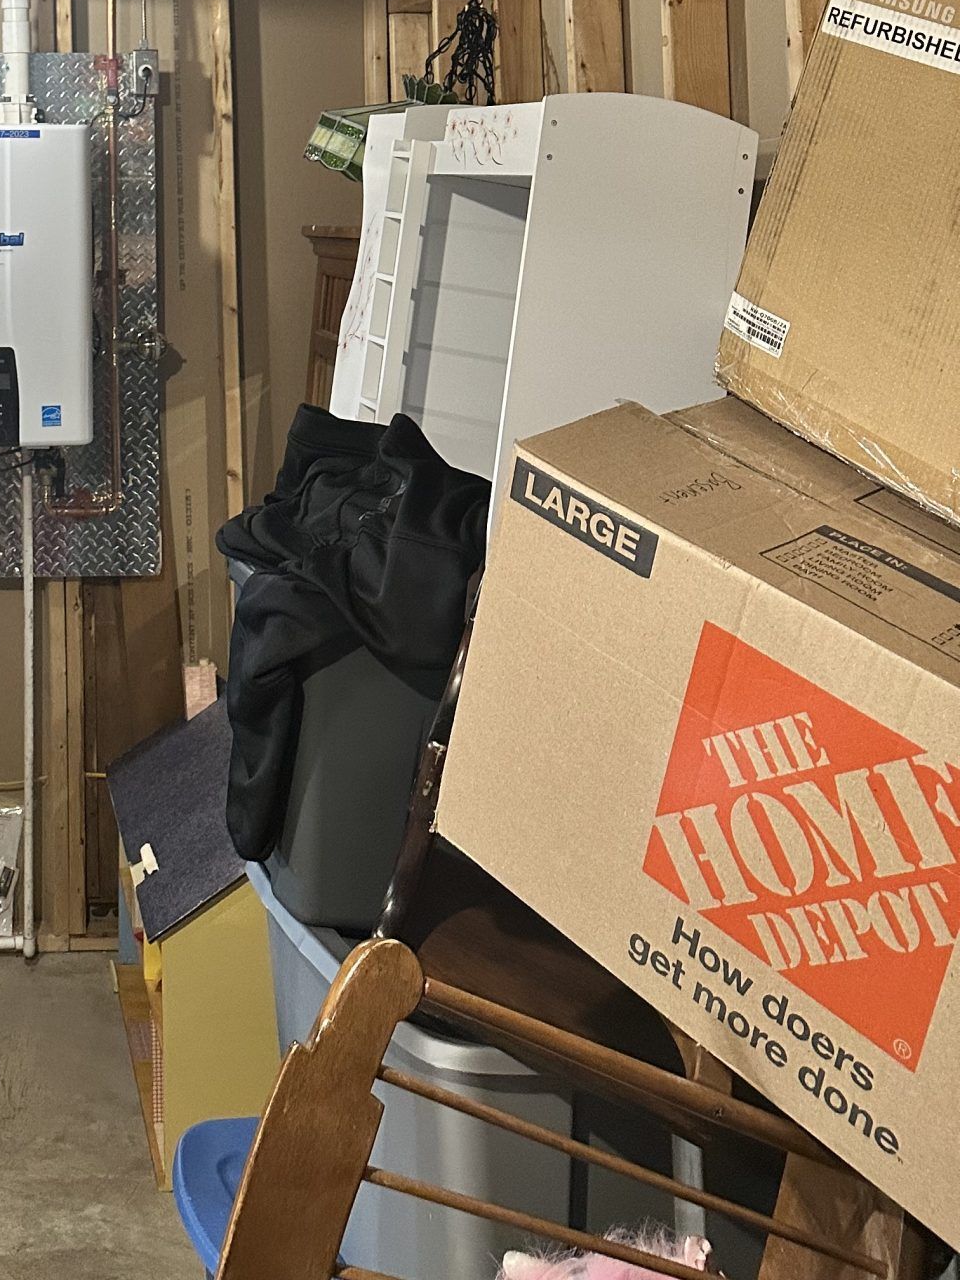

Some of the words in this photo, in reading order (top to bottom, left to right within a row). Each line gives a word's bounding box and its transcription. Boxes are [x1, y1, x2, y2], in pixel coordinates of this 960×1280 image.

[523, 472, 642, 562] LARGE
[793, 564, 823, 579] BATH
[824, 549, 882, 579] BEDROOM
[829, 531, 883, 557] PLACE
[884, 556, 907, 571] IN:
[833, 545, 878, 569] MASTER
[800, 560, 840, 580] DINING
[841, 580, 877, 601] ROOM
[808, 557, 845, 575] LIVING
[846, 574, 882, 596] ROOM
[816, 553, 856, 572] FAMILY
[857, 572, 894, 592] ROOM
[701, 712, 830, 788] THE
[652, 757, 960, 910] HOME
[747, 882, 955, 971] DEPOT
[671, 916, 753, 996] How
[762, 994, 874, 1091] doers
[628, 933, 685, 990] get
[692, 981, 788, 1068] more
[798, 1066, 899, 1155] done
